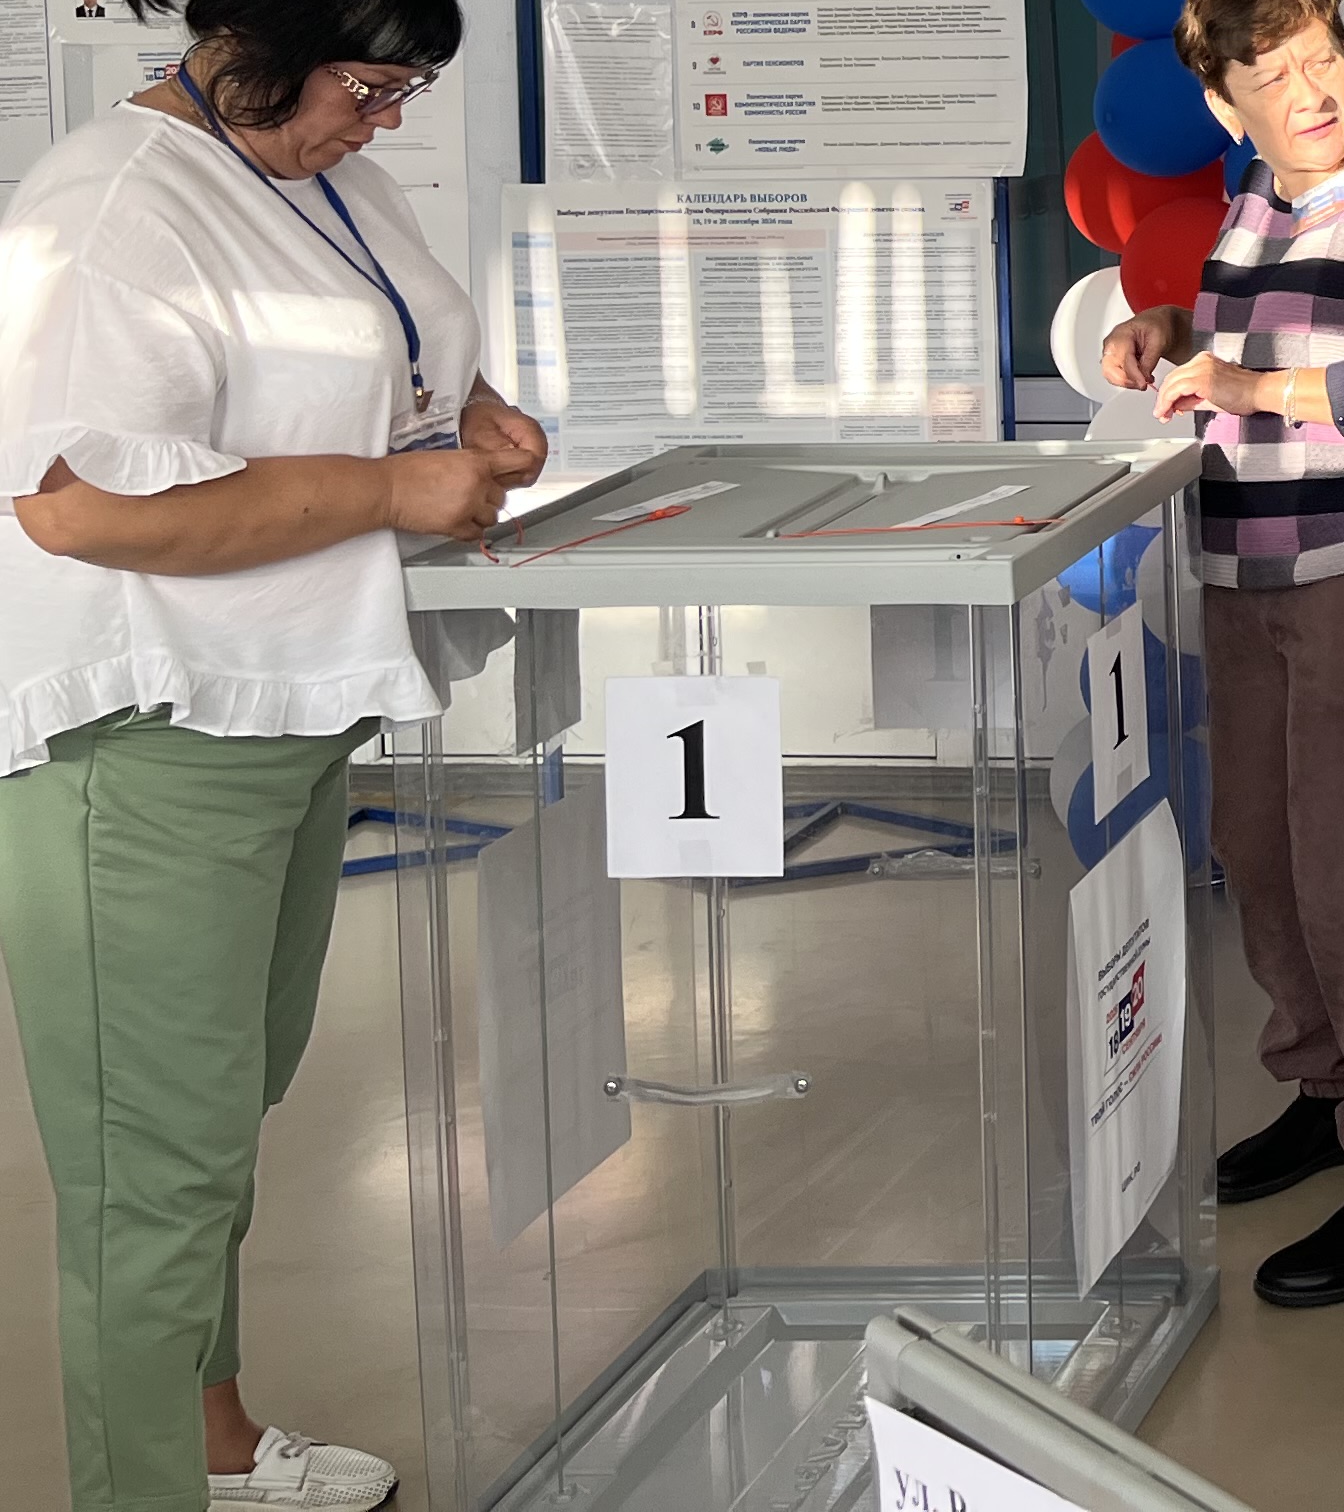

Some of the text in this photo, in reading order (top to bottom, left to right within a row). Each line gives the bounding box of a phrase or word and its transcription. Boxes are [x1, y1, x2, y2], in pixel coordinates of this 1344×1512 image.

[676, 193, 808, 204] КАЛЕНДАРЬ ВЫБОРОВ
[1113, 650, 1131, 751] 1
[667, 719, 720, 819] 1
[1109, 976, 1144, 1059] 18 19 20
